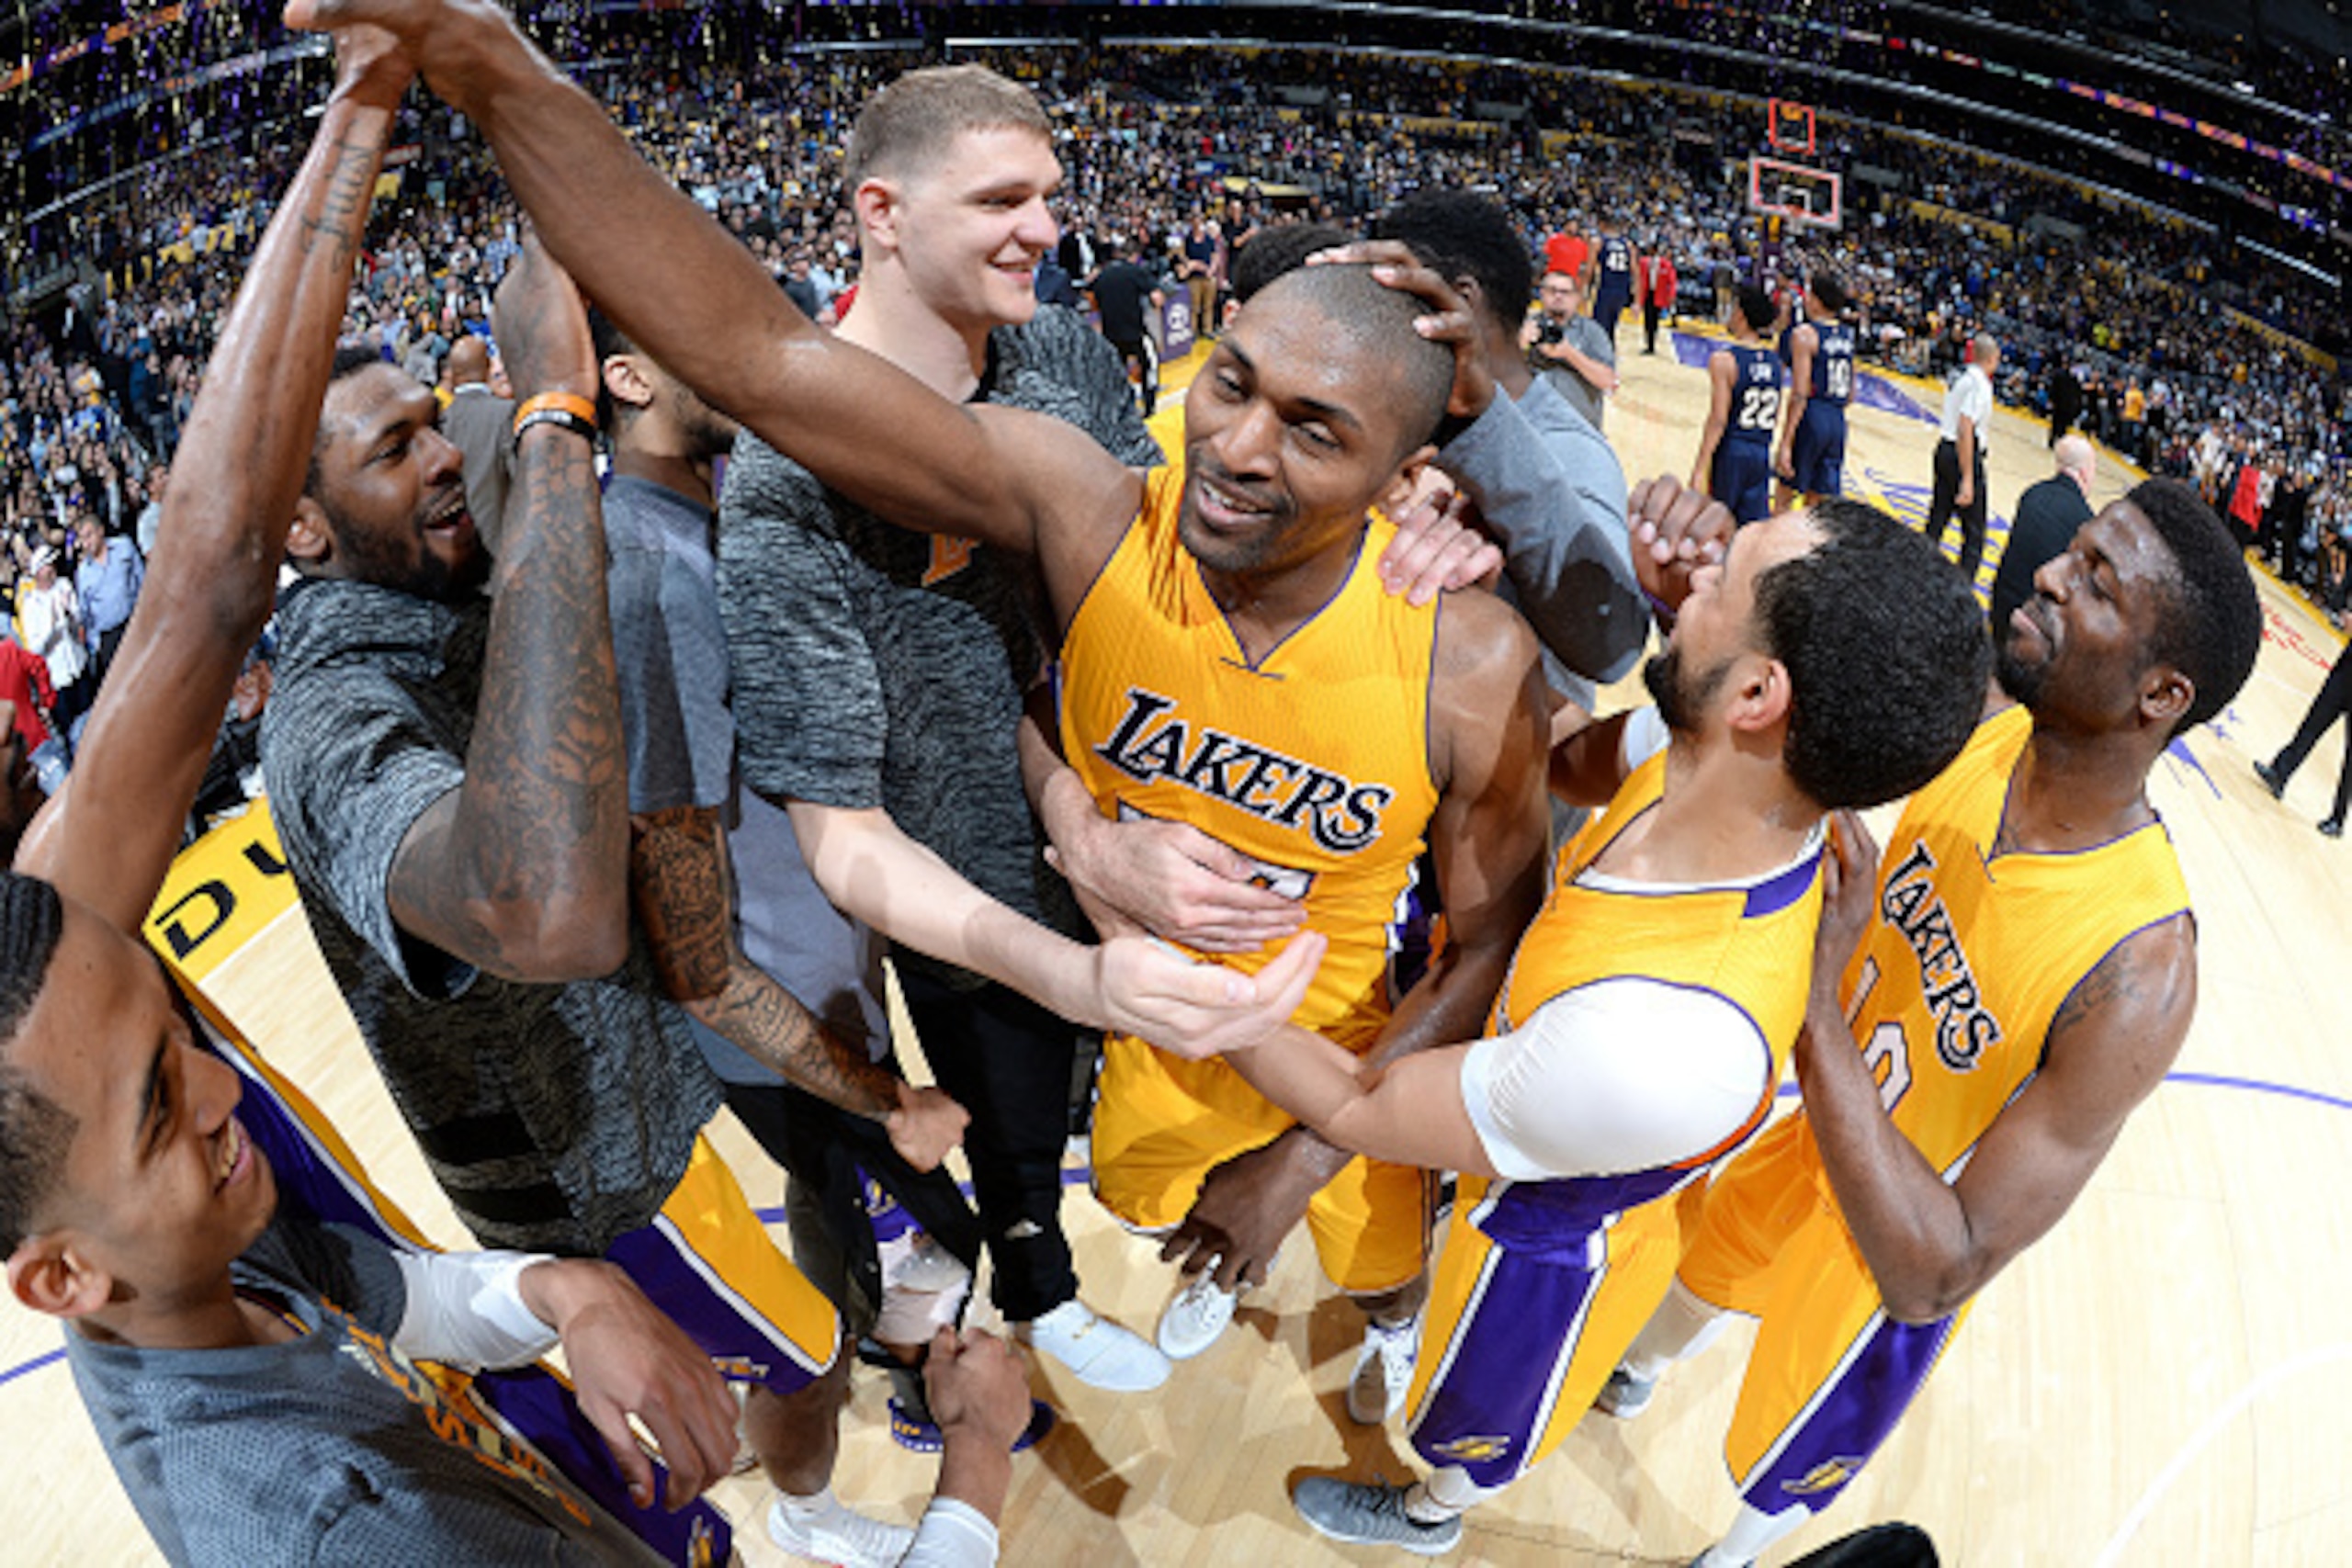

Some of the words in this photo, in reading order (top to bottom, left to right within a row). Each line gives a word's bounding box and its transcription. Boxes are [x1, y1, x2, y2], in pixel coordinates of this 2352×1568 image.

[1738, 386, 1780, 430] 22
[1826, 357, 1851, 399] 10
[1092, 685, 1396, 857] LAKERS
[1881, 838, 2005, 1075] LAKERS
